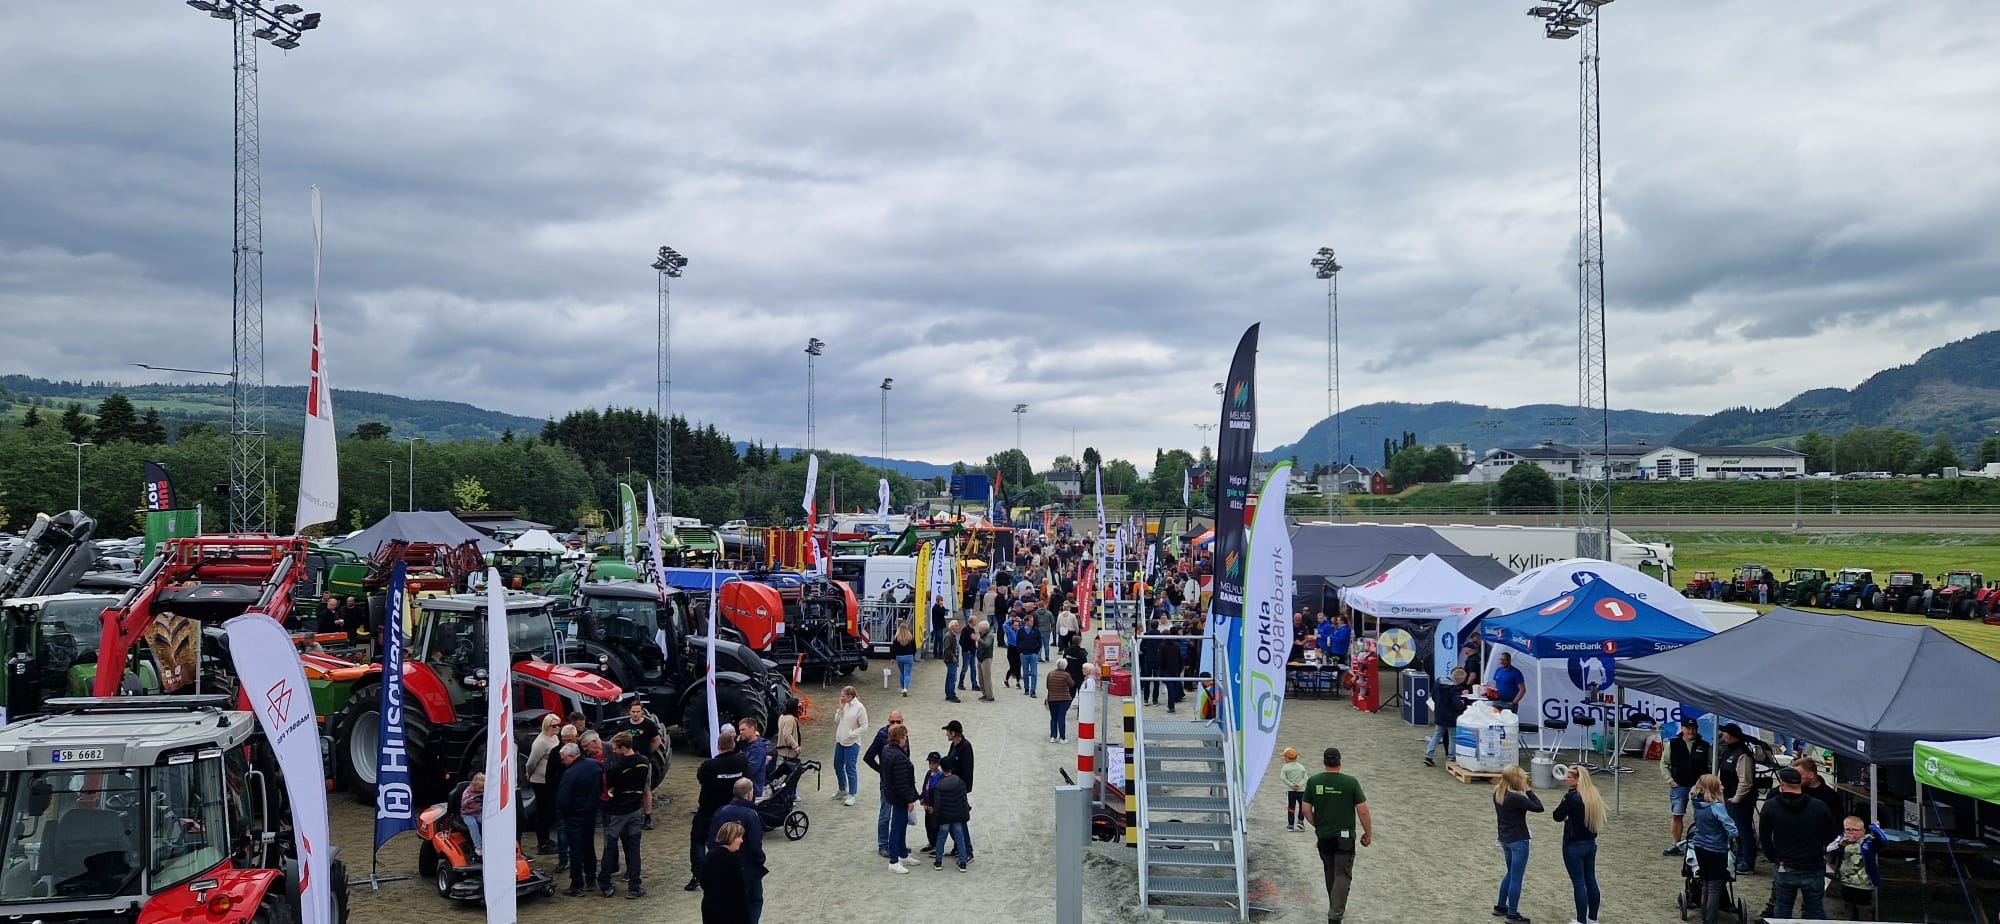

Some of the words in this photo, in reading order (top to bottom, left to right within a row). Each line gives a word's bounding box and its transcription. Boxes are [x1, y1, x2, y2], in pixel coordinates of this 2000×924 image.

[1230, 421, 1251, 430] BANKEN
[1220, 591, 1243, 605] BANKE
[1604, 601, 1624, 617] 1
[1258, 601, 1271, 665] Orkla
[1555, 642, 1602, 651] SpareBank
[62, 750, 73, 760] SB
[78, 749, 102, 760] 6682
